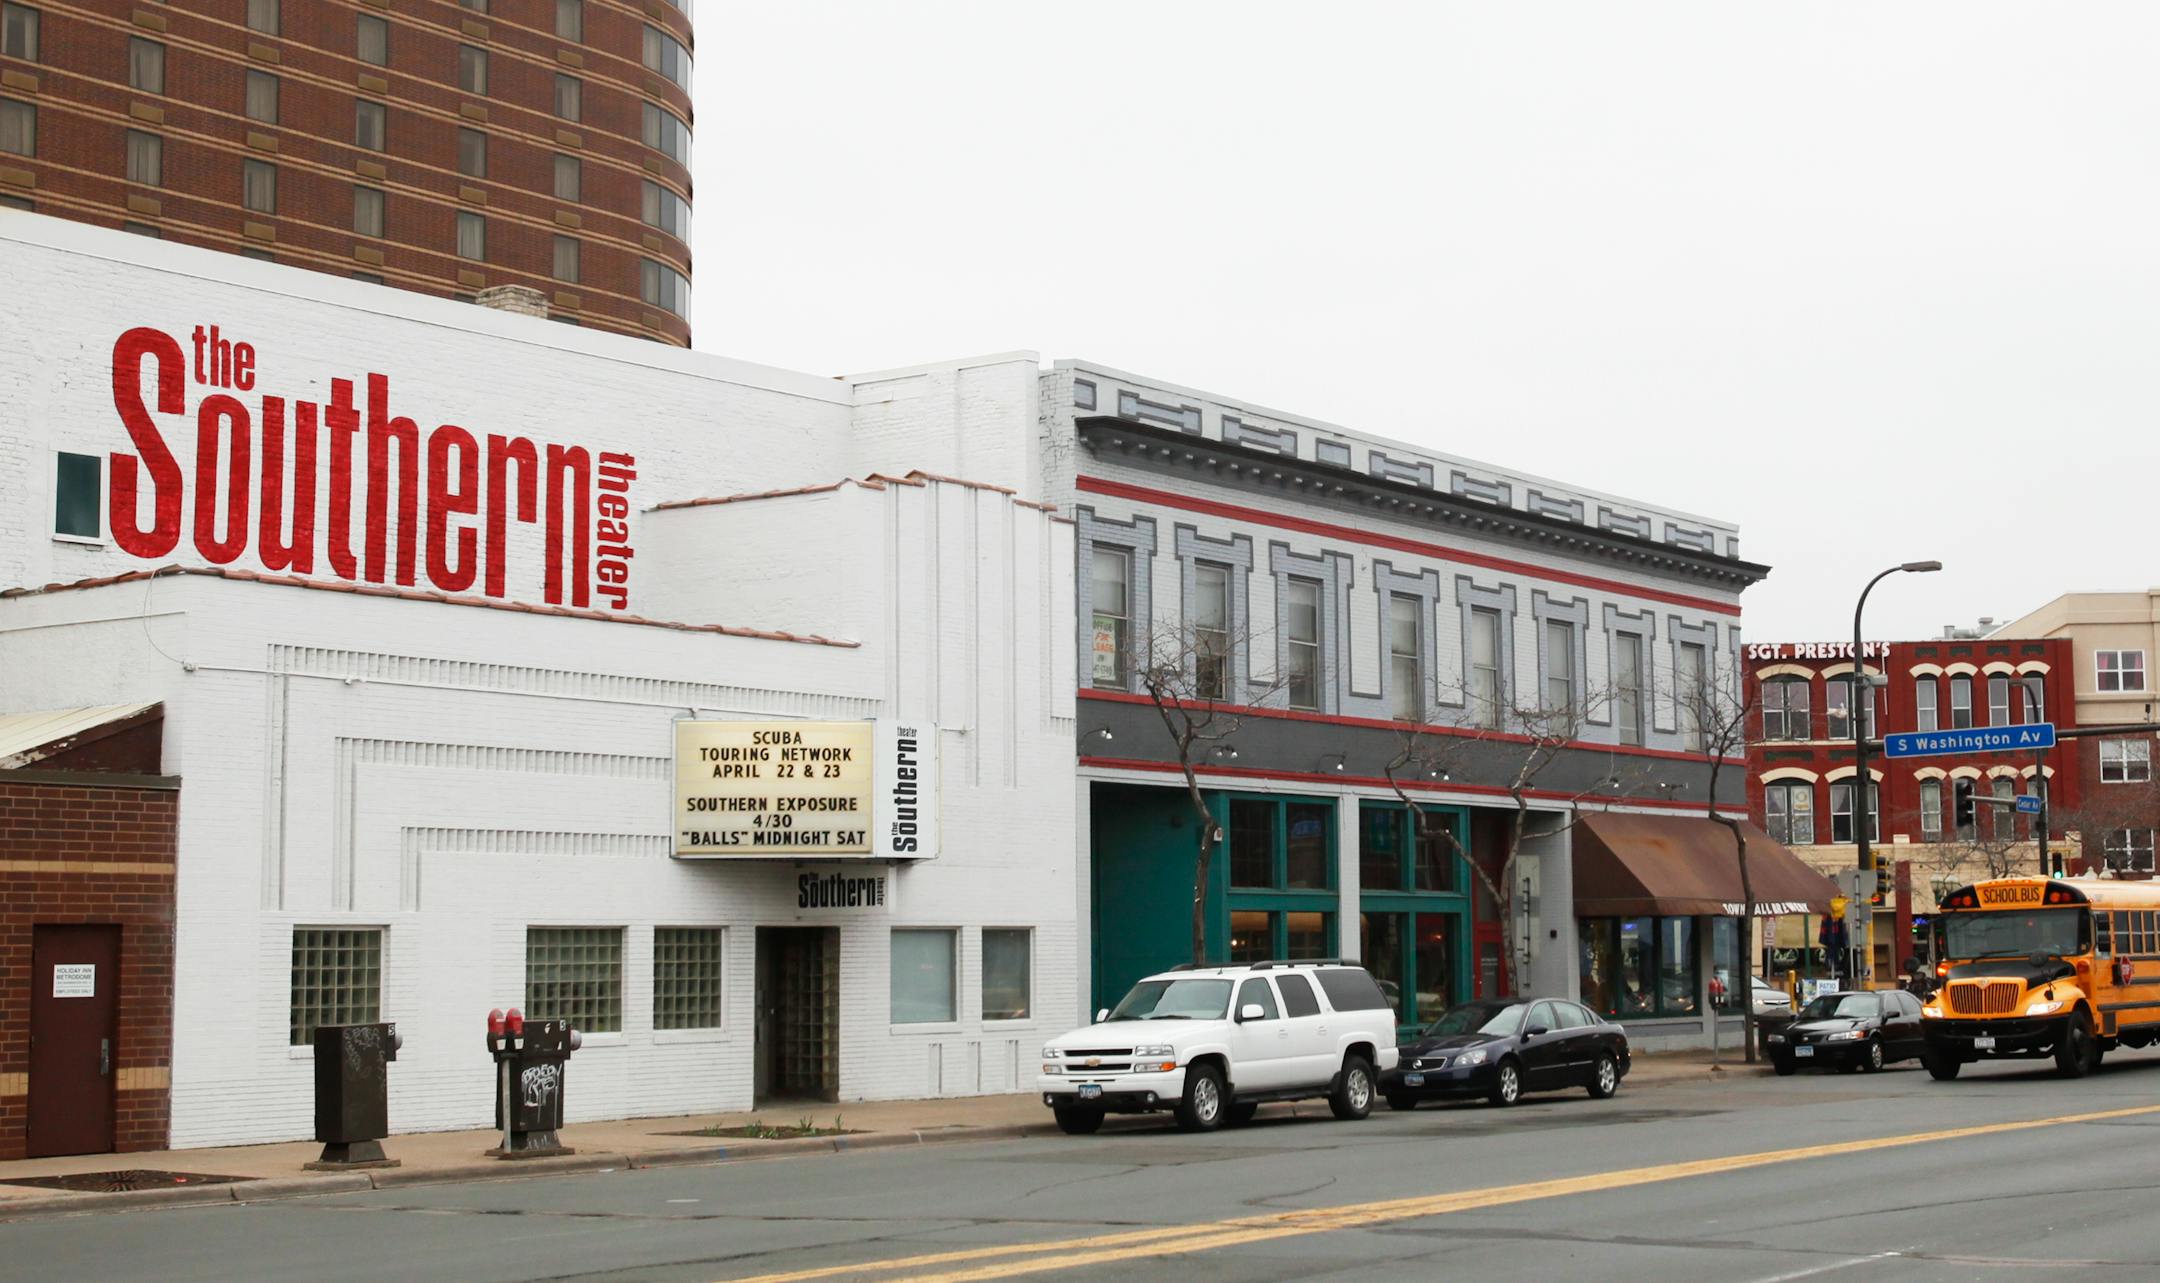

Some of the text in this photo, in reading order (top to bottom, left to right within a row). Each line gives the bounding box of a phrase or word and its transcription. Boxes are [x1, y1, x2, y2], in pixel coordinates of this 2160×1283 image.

[192, 325, 255, 391] the
[109, 326, 591, 608] Southern
[596, 451, 637, 610] theater
[1748, 643, 1788, 660] SGT.
[753, 731, 802, 745] SCUBA
[897, 726, 917, 738] theater
[1898, 730, 2041, 751] S Washington Av
[700, 747, 852, 761] TOURING NETWORK
[712, 764, 841, 778] APRIL 22 & 23
[893, 739, 917, 852] Southern
[687, 798, 858, 811] SOUTHERN EXPOSURE
[753, 814, 793, 828] 4/30
[753, 831, 831, 845] MIDNIGHT
[837, 831, 866, 845] SAT
[798, 872, 876, 908] Southern
[877, 877, 885, 906] theater
[1983, 886, 2040, 904] SCHOOL BUS
